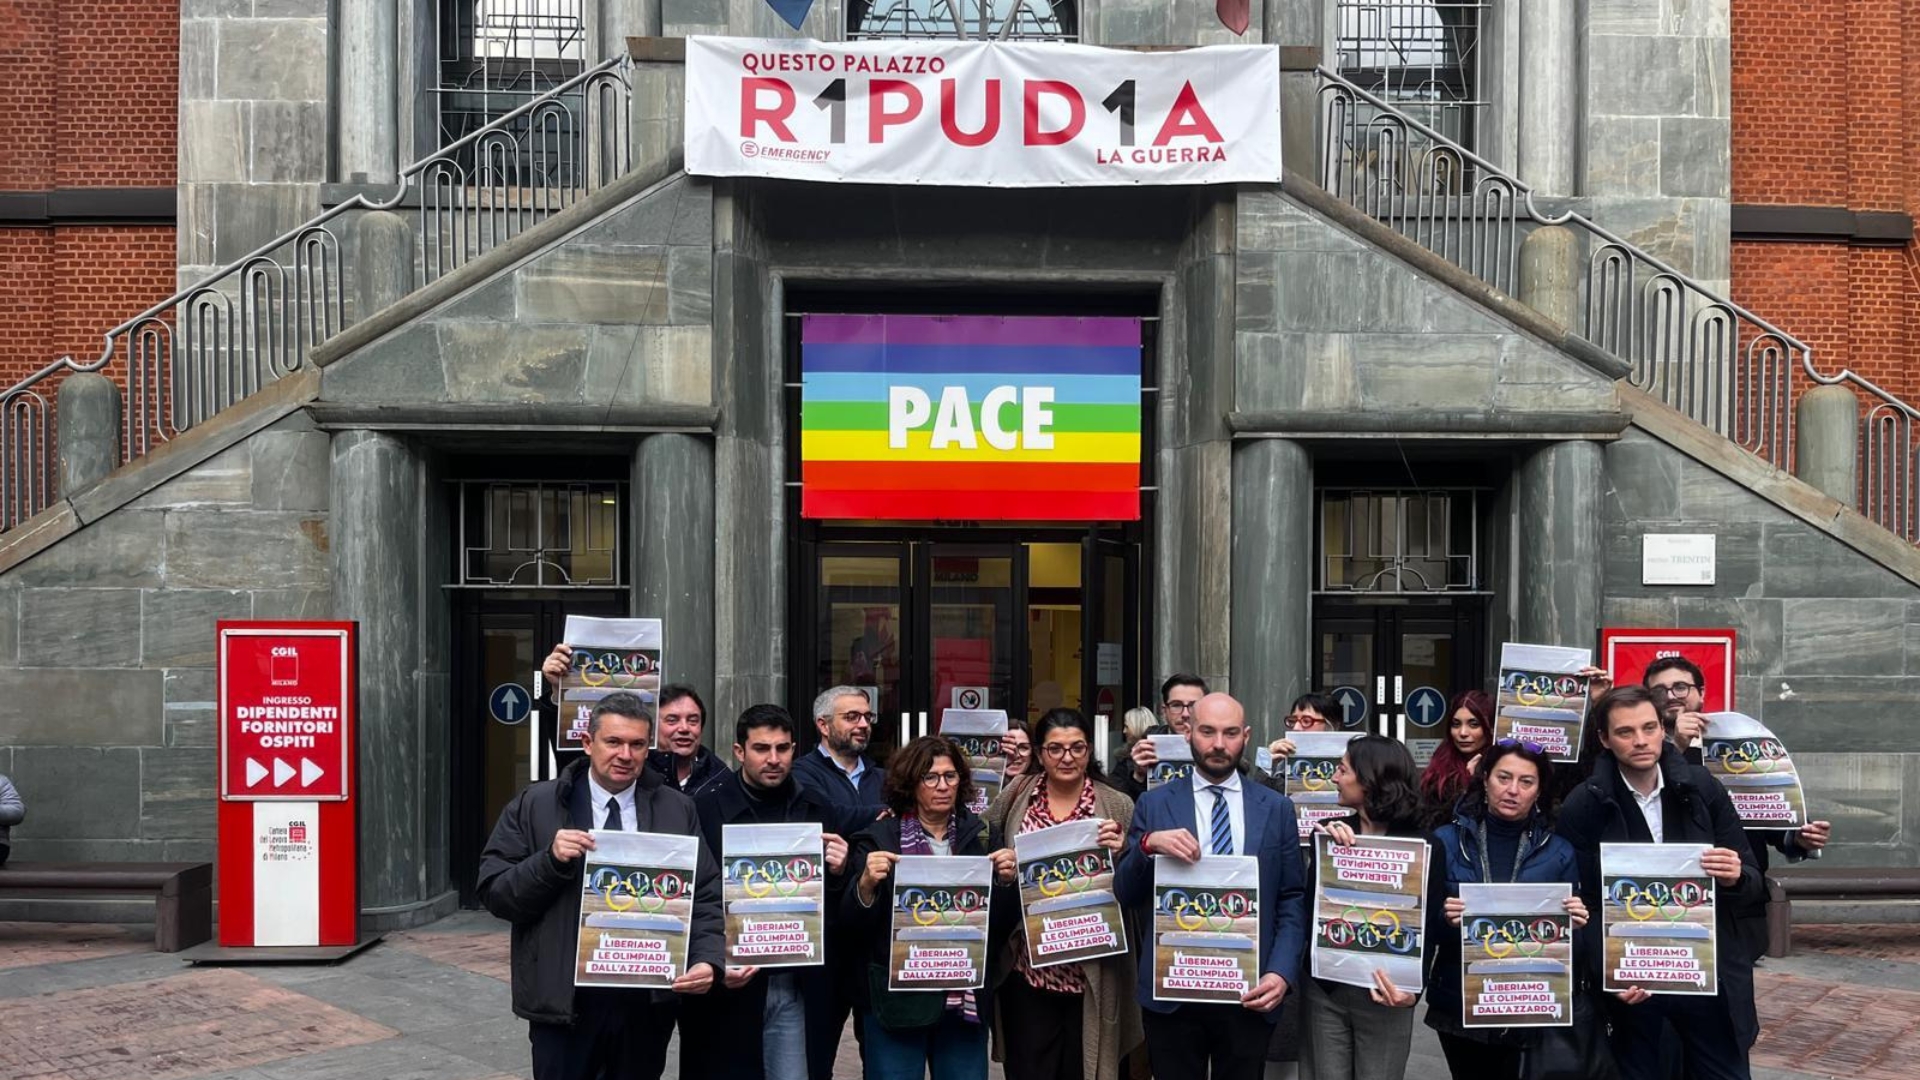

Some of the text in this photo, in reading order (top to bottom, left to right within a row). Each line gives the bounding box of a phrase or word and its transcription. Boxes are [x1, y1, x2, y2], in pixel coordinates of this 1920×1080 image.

[743, 53, 945, 74] QUESTO PALAZZO
[740, 76, 1225, 147] R1PUD1A
[761, 146, 831, 160] EMERGENCY
[1097, 145, 1226, 164] LA GUERRA
[890, 386, 1055, 450] PACE
[1670, 555, 1710, 564] TRENTIN
[934, 573, 979, 582] MILANO
[271, 647, 298, 656] CGIL
[262, 696, 312, 705] INGRESSO
[237, 706, 337, 719] DIPENDENTI
[241, 721, 333, 734] FORNITORI
[1516, 726, 1561, 734] LIBERIAMO
[260, 735, 315, 748] OSPITI
[1338, 859, 1388, 870] OLIMPIADI
[1342, 871, 1397, 882] LIBERIAMO
[748, 922, 800, 931] LIBERIAMO
[1048, 915, 1098, 930] LIBERIAMO
[743, 933, 804, 943] LE OLIMPIADI
[1046, 925, 1105, 941] LE OLIMPIADI
[605, 939, 662, 949] LIBERIAMO
[1042, 935, 1112, 952] DALL'AZZARDO
[738, 944, 809, 954] DALL'AZZARDO
[1630, 948, 1687, 956] LIBERIAMO
[598, 952, 666, 961] LE OLIMPIADI
[921, 960, 967, 968] OLIMPIADI
[1179, 958, 1233, 966] LIBERIAMO
[1639, 960, 1694, 968] OLIMPIADI
[591, 964, 670, 974] DALL'AZZARDO
[1187, 969, 1238, 978] OLIMPIADI
[903, 970, 972, 979] DALL'AZZARDO
[1619, 971, 1701, 980] DALL'AZZARDO
[1168, 979, 1244, 990] DALL'AZZARDO
[1488, 983, 1544, 991] LIBERIAMO
[1497, 994, 1550, 1002] OLIMPIADI
[1478, 1005, 1556, 1014] DALL'AZZARDO
